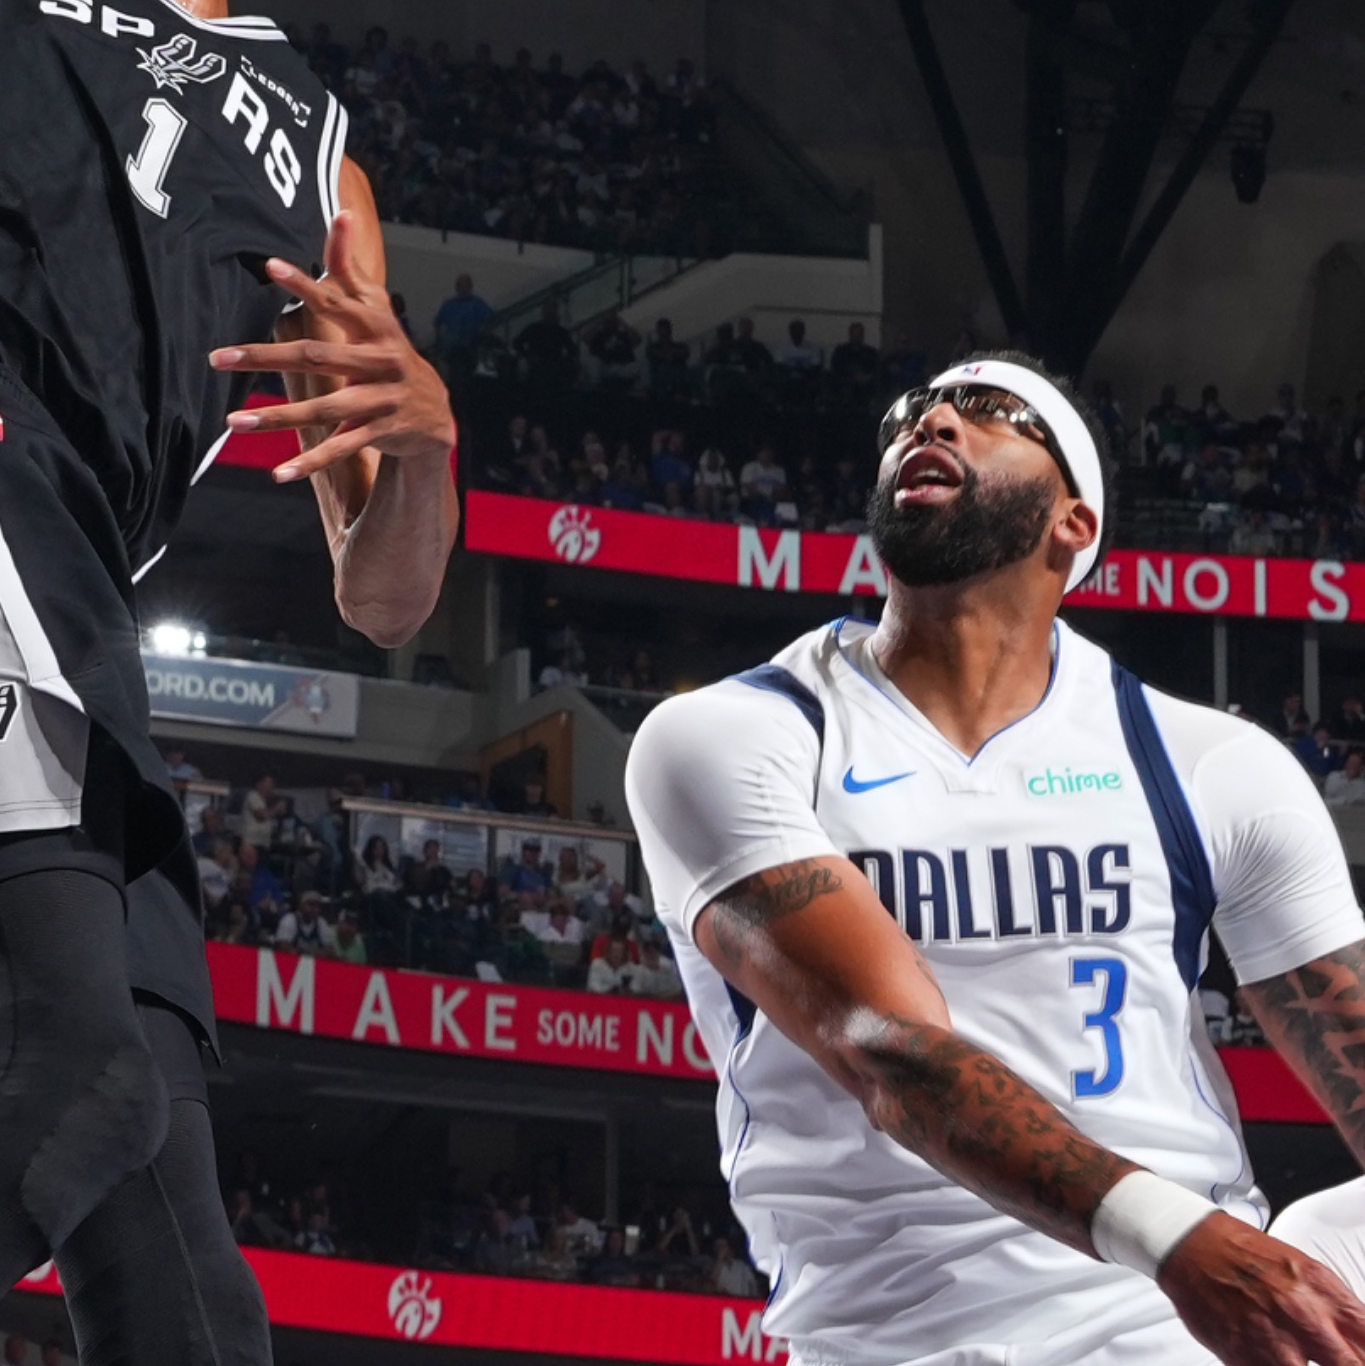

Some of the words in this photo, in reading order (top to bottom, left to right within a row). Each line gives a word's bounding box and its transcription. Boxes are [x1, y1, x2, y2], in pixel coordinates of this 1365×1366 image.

[125, 97, 189, 220] 1
[1135, 557, 1351, 622] NOIS
[1027, 766, 1122, 796] chime
[847, 842, 1132, 943] DALLAS
[255, 947, 517, 1051] MAKE
[537, 1009, 620, 1051] SOME
[1069, 955, 1129, 1104] 3
